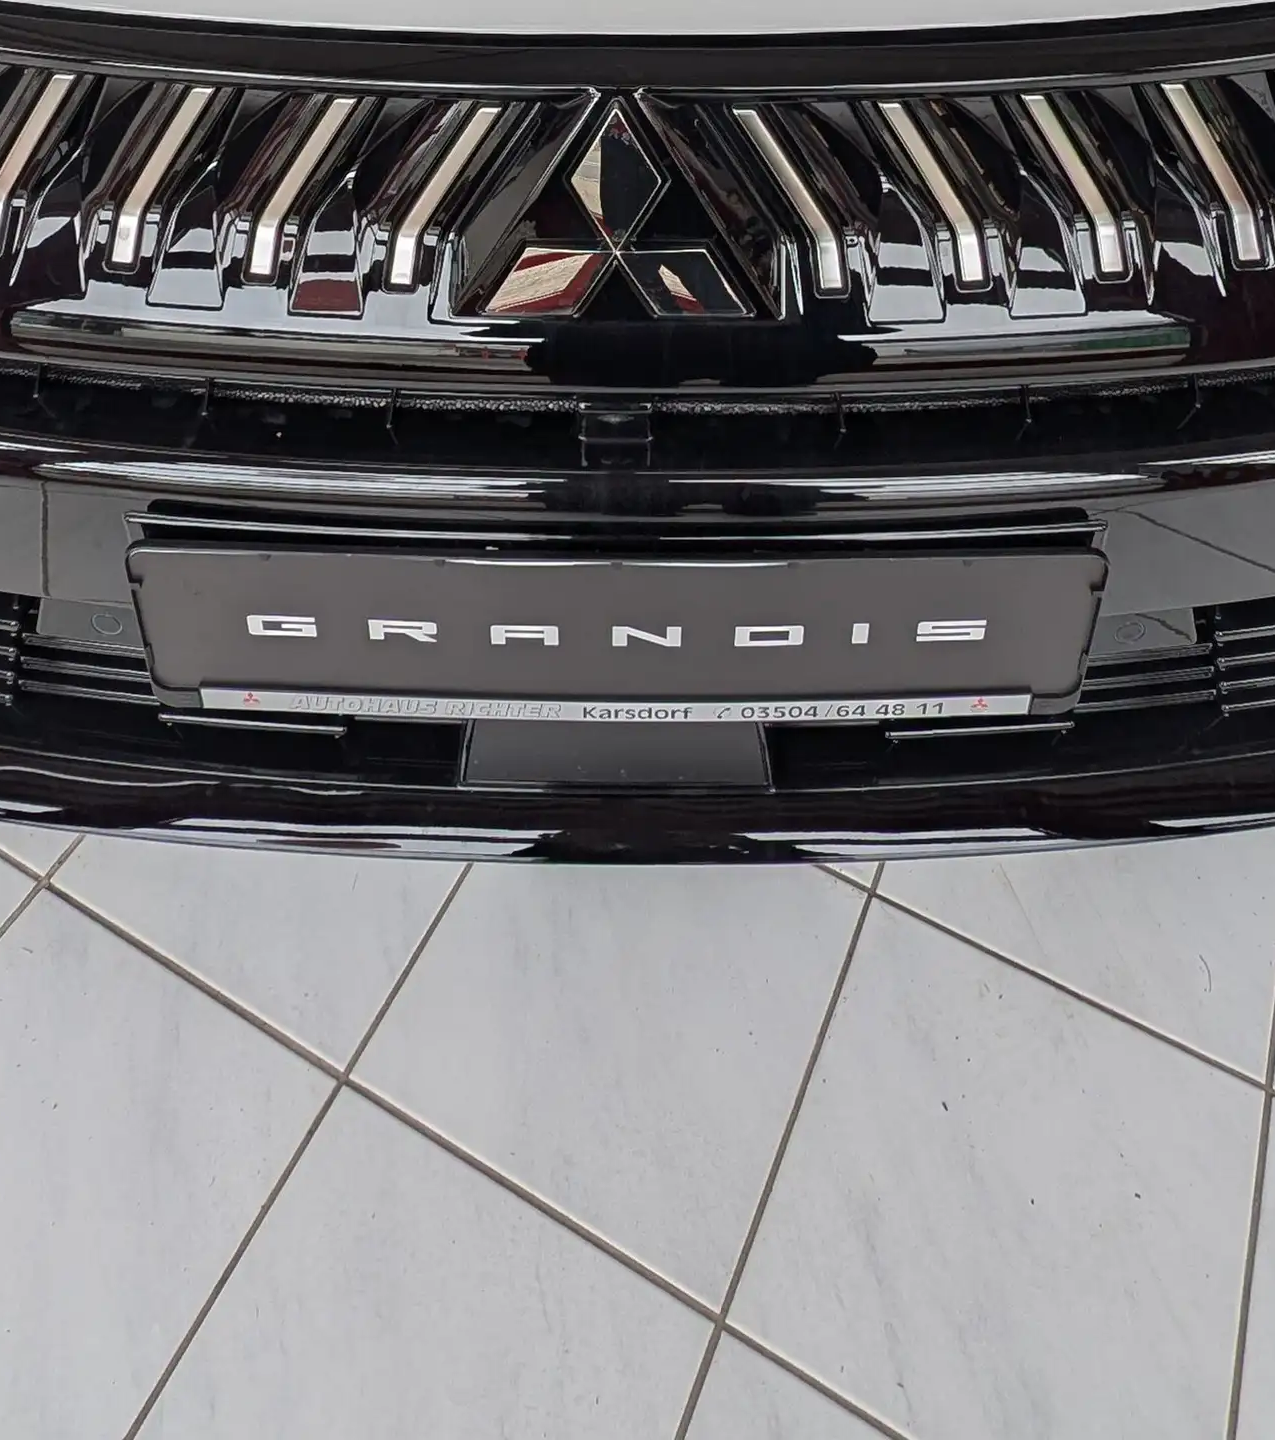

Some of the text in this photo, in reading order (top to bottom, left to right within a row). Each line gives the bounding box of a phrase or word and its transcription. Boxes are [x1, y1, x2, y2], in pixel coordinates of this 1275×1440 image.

[246, 614, 988, 647] GRANDIS
[290, 694, 437, 716] AUTOHAUS
[444, 699, 562, 718] RICHTER
[582, 706, 693, 720] Karsdorf
[876, 703, 906, 716] 48
[916, 702, 944, 715] 11
